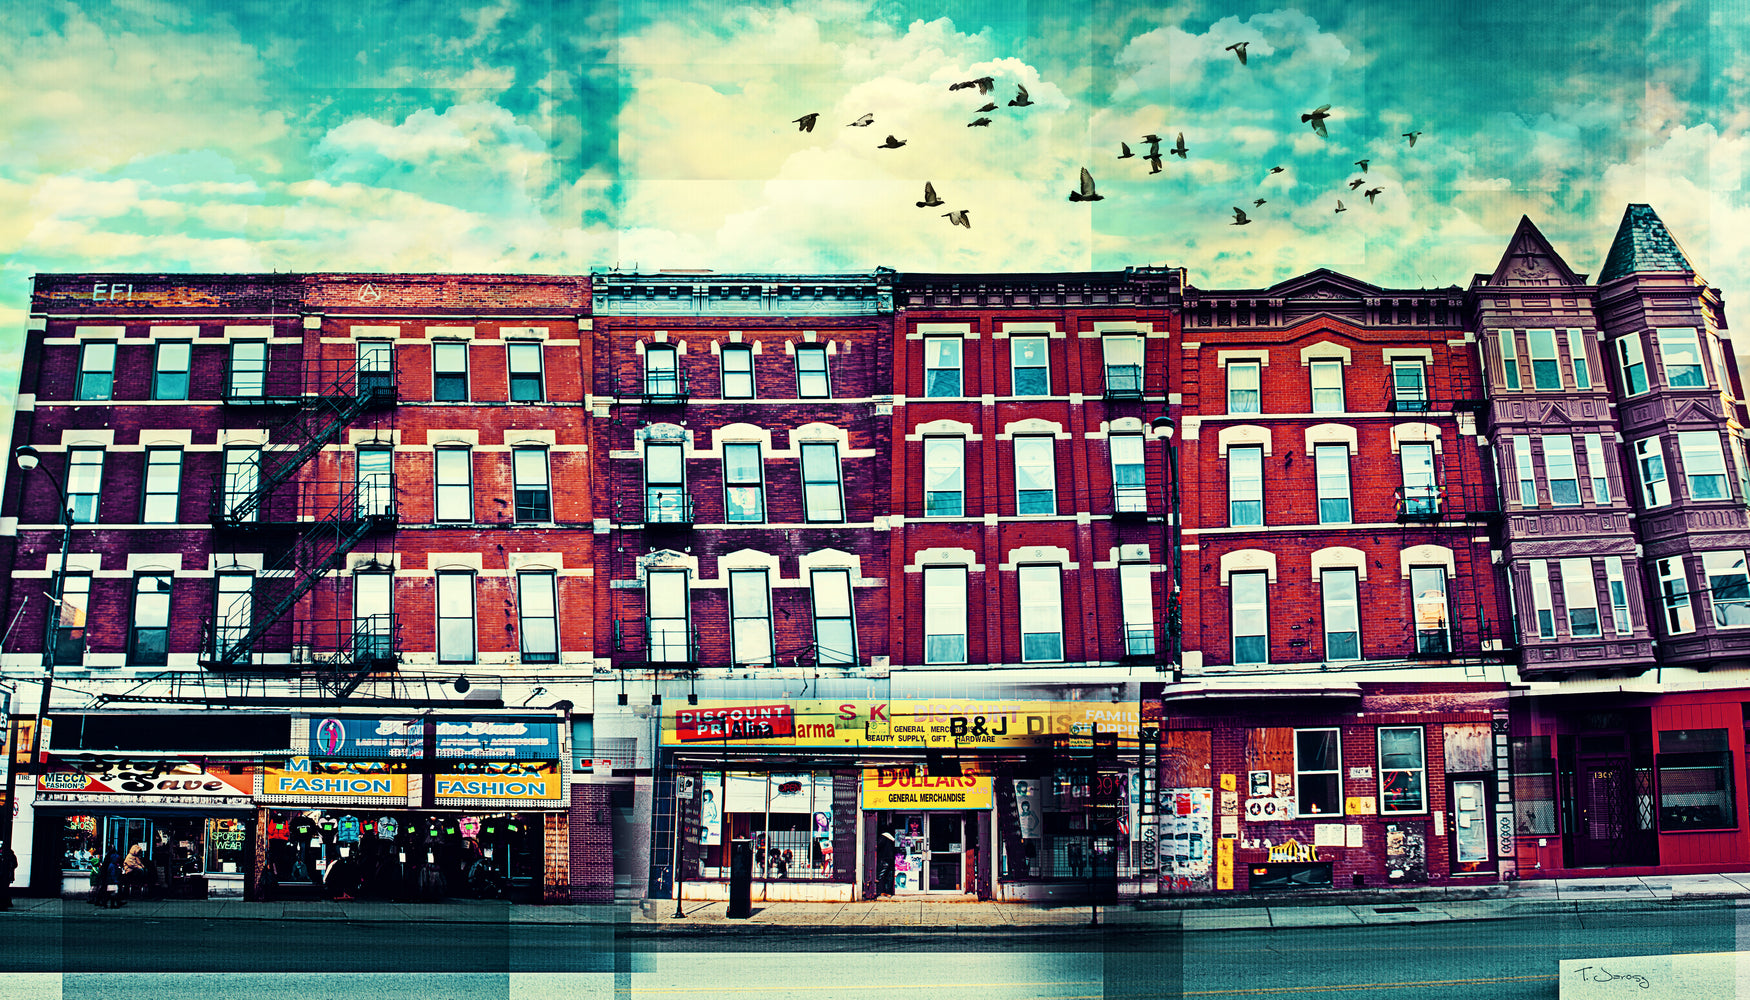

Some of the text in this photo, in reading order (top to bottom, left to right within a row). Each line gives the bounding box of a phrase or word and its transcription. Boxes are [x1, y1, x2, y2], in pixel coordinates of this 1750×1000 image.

[681, 707, 785, 724] DISCOUNT
[913, 704, 1021, 724] DISCOUNT
[697, 721, 769, 736] PRICES
[893, 725, 926, 733] GENERAL
[950, 716, 1008, 737] B&J
[866, 734, 895, 742] BEAUTY
[955, 735, 996, 743] HARDWARE
[44, 773, 87, 783] MECCA
[118, 772, 223, 792] Save
[279, 777, 392, 793] FASHION
[436, 781, 546, 796] FASHION
[778, 783, 802, 792] OPEN
[888, 793, 966, 803] GENERAL MERCHANDISE
[211, 831, 246, 841] SPORTS
[215, 841, 242, 851] WEAR
